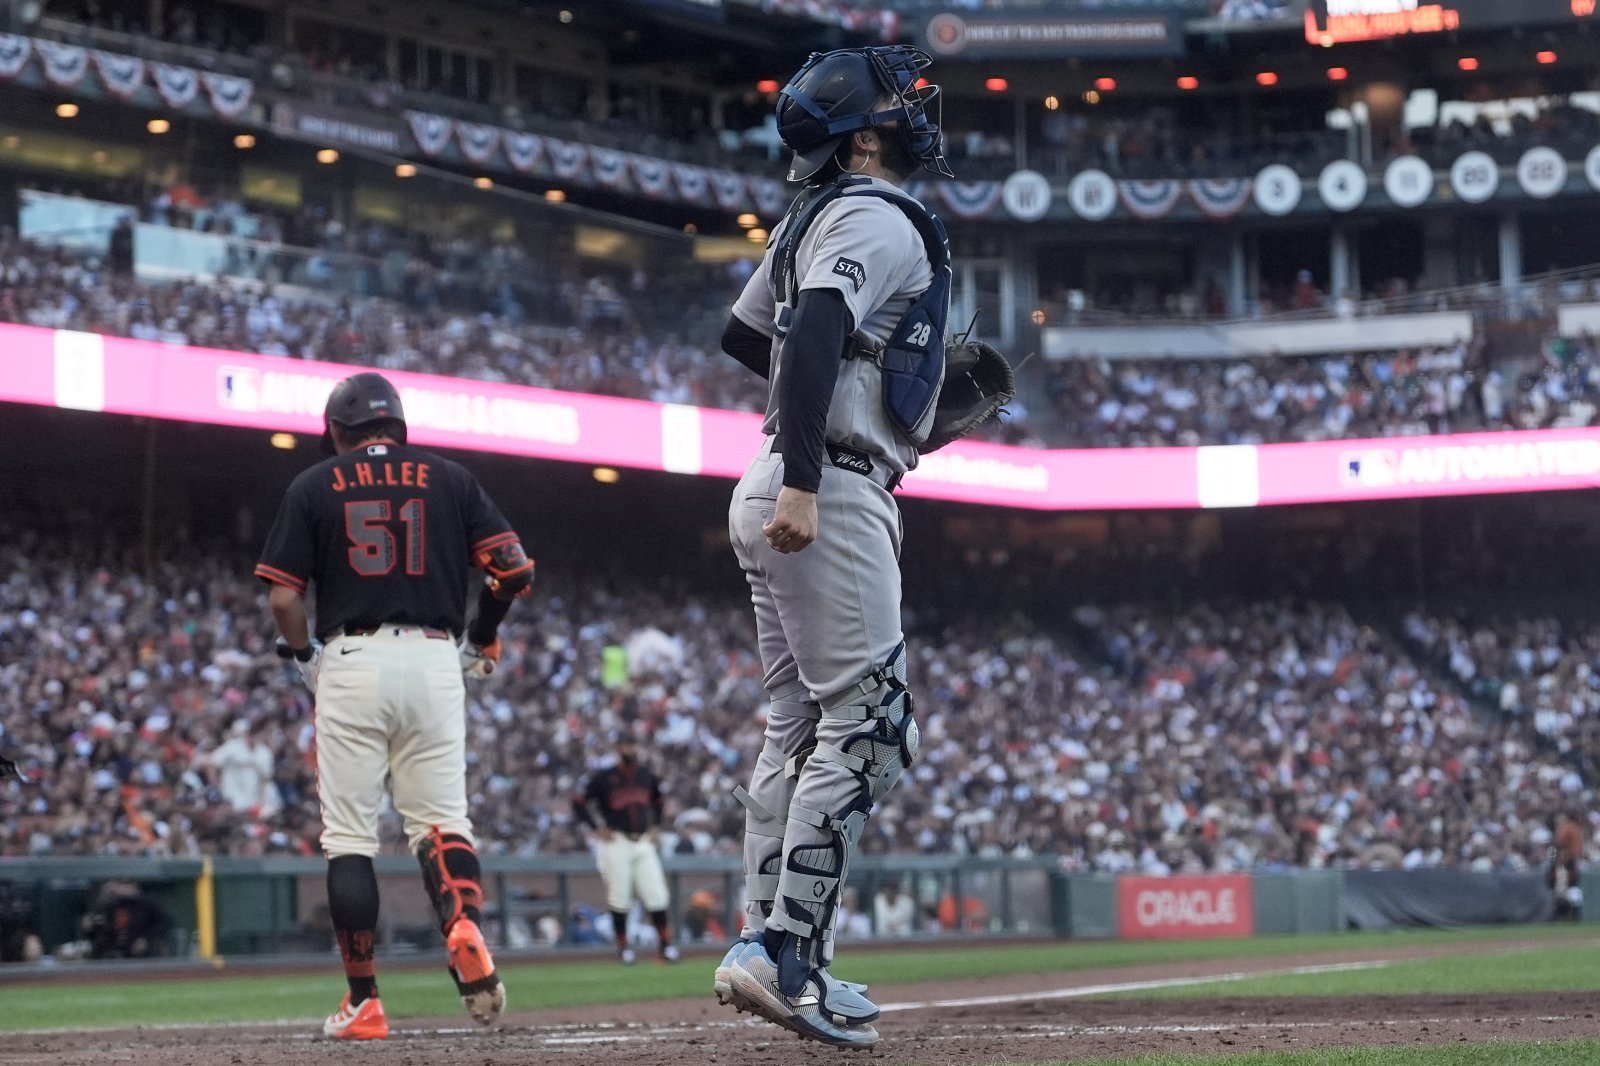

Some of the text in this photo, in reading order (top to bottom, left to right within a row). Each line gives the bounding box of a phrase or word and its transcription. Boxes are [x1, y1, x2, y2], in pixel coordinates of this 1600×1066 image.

[906, 321, 931, 347] 28
[836, 451, 869, 471] Wells
[1399, 439, 1600, 483] AUTOMATED
[344, 498, 425, 576] 51
[1136, 887, 1237, 927] ORACLE
